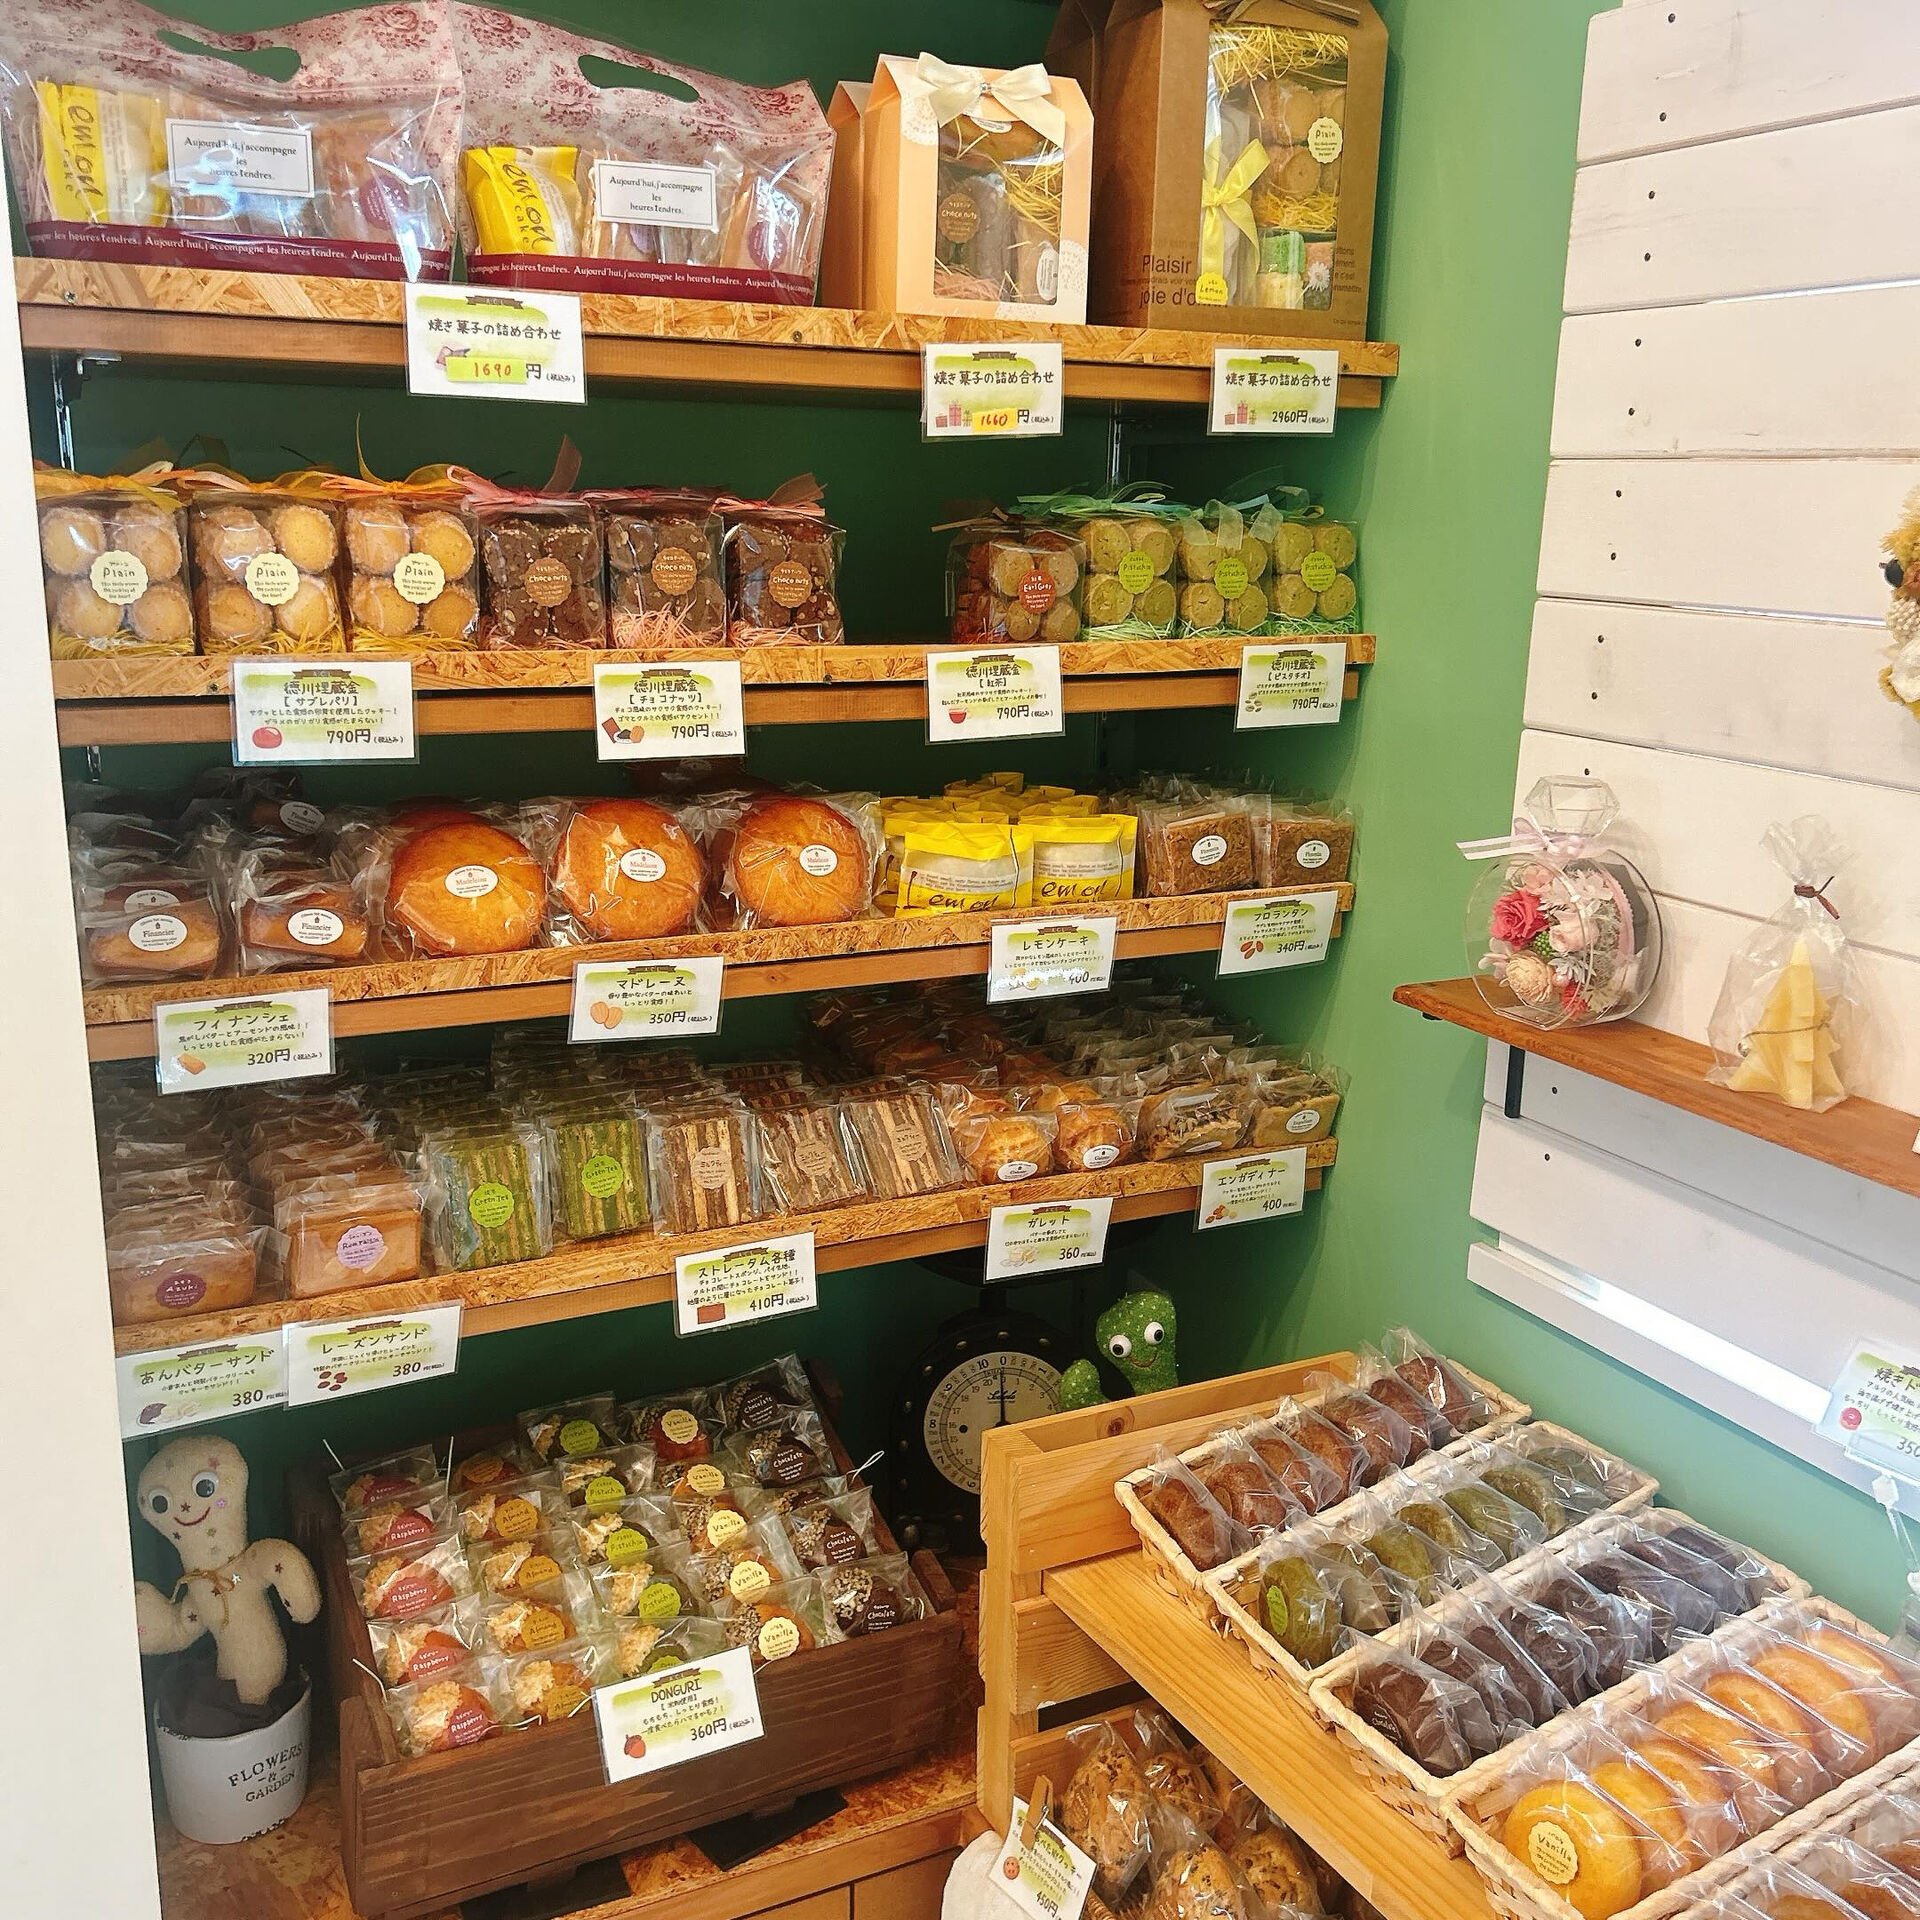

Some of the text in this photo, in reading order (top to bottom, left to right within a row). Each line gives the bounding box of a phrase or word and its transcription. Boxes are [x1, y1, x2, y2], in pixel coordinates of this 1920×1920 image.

[656, 180, 702, 193] j'accompagne
[652, 193, 661, 201] les
[630, 202, 653, 212] heures
[69, 232, 99, 242] heures
[267, 245, 279, 254] les
[281, 246, 310, 256] heures
[1142, 254, 1191, 274] Plaisir
[511, 262, 536, 272] heures
[674, 272, 685, 281] les
[687, 273, 711, 284] heures
[1139, 286, 1166, 309] joie
[428, 318, 561, 341] 焼き菓子の詰め合わせ
[473, 361, 512, 377] 1690
[525, 363, 542, 379] 円
[934, 370, 1054, 386] 焼き菓子の詰め合わせ
[1225, 372, 1332, 387] 焼き菓子の詰め合わせ
[981, 409, 1030, 426] 1660 円
[1272, 410, 1308, 423] 2960円
[103, 567, 135, 579] Plain
[256, 567, 287, 578] Plain
[404, 565, 434, 576] Plain
[965, 663, 1022, 678] 徳川埋蔵金
[1271, 659, 1318, 672] 徳川埋蔵金
[284, 681, 361, 696] 徳川埋蔵金
[634, 679, 699, 693] 徳川埋蔵金
[1292, 696, 1319, 709] 790円
[996, 704, 1029, 719] 790円
[326, 729, 371, 744] 790円
[671, 723, 709, 739] 790円
[1254, 908, 1309, 922] フロランタン
[1023, 935, 1089, 951] レモンケーキ
[616, 976, 686, 989] マドレーヌ
[194, 1013, 289, 1031] フィナンシェ
[650, 1011, 686, 1024] 350円
[247, 1048, 290, 1066] 320円
[1218, 1168, 1286, 1186] エンガディナー
[1262, 1198, 1282, 1212] 400
[1028, 1215, 1070, 1228] ガレット
[1059, 1247, 1080, 1260] 360
[698, 1248, 796, 1278] ストレータム各種
[166, 1284, 198, 1292] Azuki
[749, 1293, 784, 1312] 410円
[322, 1327, 427, 1354] レーズンサンド
[140, 1349, 275, 1385] あんバターサンド
[392, 1362, 421, 1378] 380
[977, 1358, 990, 1370] 10
[943, 1383, 952, 1392] 9
[232, 1389, 264, 1407] 380
[744, 1396, 773, 1414] Chocolate
[928, 1418, 936, 1428] 8
[773, 1452, 803, 1468] Chocolate
[712, 1519, 740, 1532] Vanilla
[391, 1527, 426, 1541] Raspberry
[827, 1535, 856, 1549] Chocolate
[735, 1570, 763, 1587] Vanilla
[392, 1587, 428, 1603] Raspberry
[413, 1656, 450, 1672] Raspberry
[651, 1678, 702, 1703] DONGURI
[451, 1714, 483, 1733] Raspberry
[690, 1717, 727, 1741] 360円
[228, 1742, 304, 1787] FLOWERS
[245, 1769, 296, 1802] GARDEN
[1537, 1834, 1572, 1862] Vanilla
